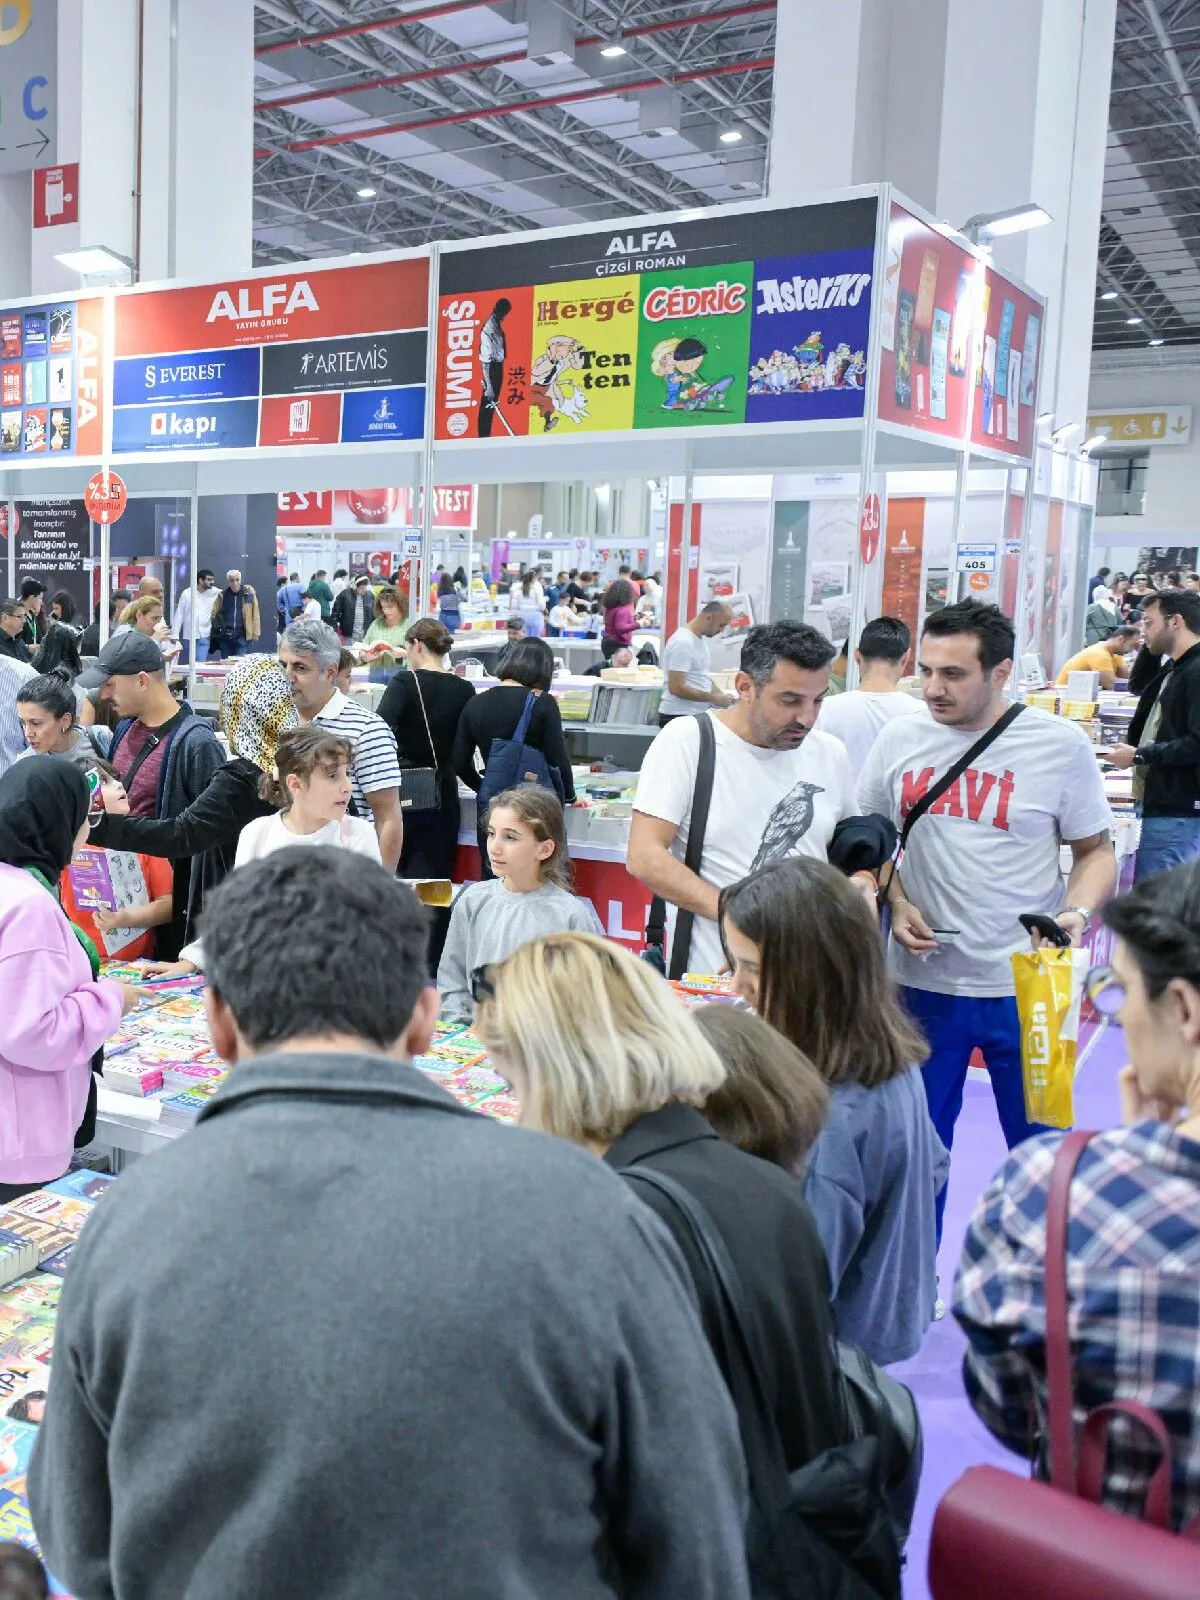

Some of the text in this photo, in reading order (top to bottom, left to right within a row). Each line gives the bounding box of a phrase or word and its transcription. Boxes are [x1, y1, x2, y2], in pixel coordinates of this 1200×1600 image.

[22, 75, 49, 121] c
[605, 230, 677, 256] ALFA
[596, 255, 686, 277] ÇİZGİ ROMAN
[205, 280, 320, 323] ALFA
[537, 291, 635, 322] Hergé
[235, 317, 289, 330] YAYIN GRUBU
[315, 344, 388, 374] ARTEMİS
[442, 300, 478, 409] ŞİBUMİ
[580, 351, 632, 369] Ten
[76, 328, 98, 428] ALFA
[160, 363, 226, 384] EVEREST
[583, 373, 631, 389] ten
[170, 412, 216, 438] kapı
[22, 509, 77, 519] tamamlanmış
[19, 562, 58, 571] müminler
[965, 561, 986, 569] 405
